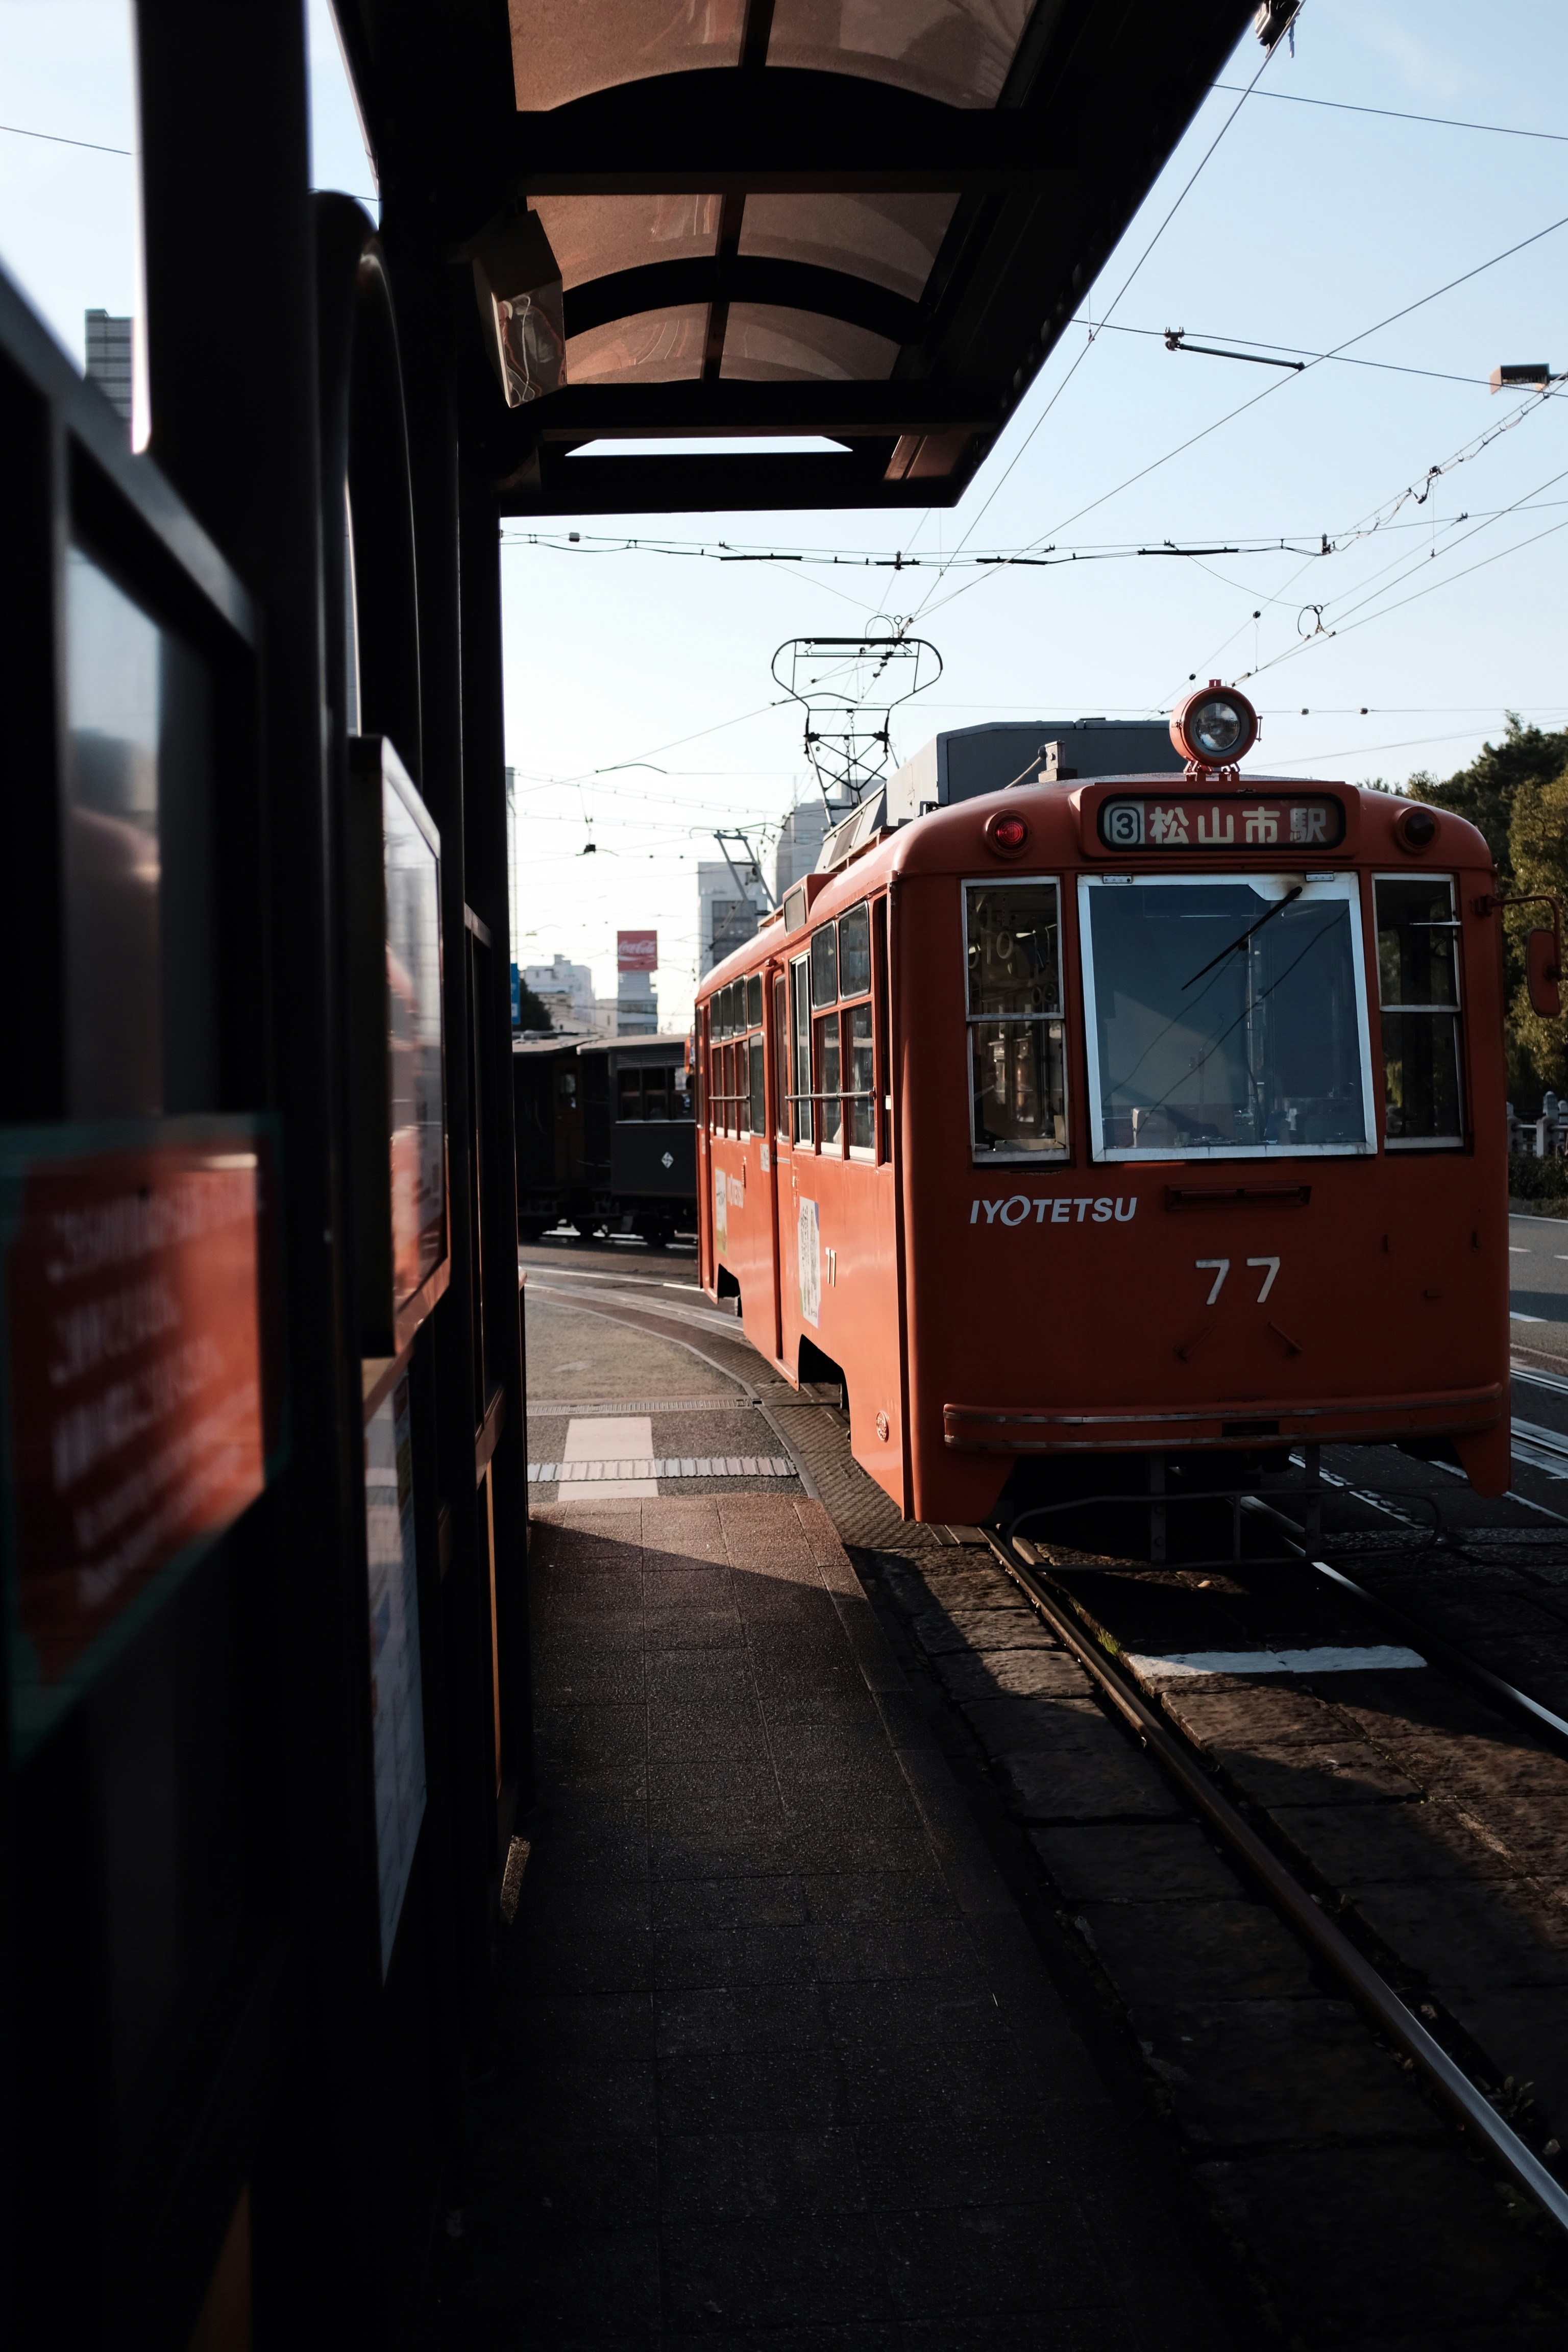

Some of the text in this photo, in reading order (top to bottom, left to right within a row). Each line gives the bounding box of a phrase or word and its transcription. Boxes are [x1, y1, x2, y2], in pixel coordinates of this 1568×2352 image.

[1149, 806, 1327, 844] 松山市駅
[970, 1195, 1137, 1226] IYOTETSU
[825, 1247, 836, 1287] 77
[1195, 1256, 1280, 1305] 77
